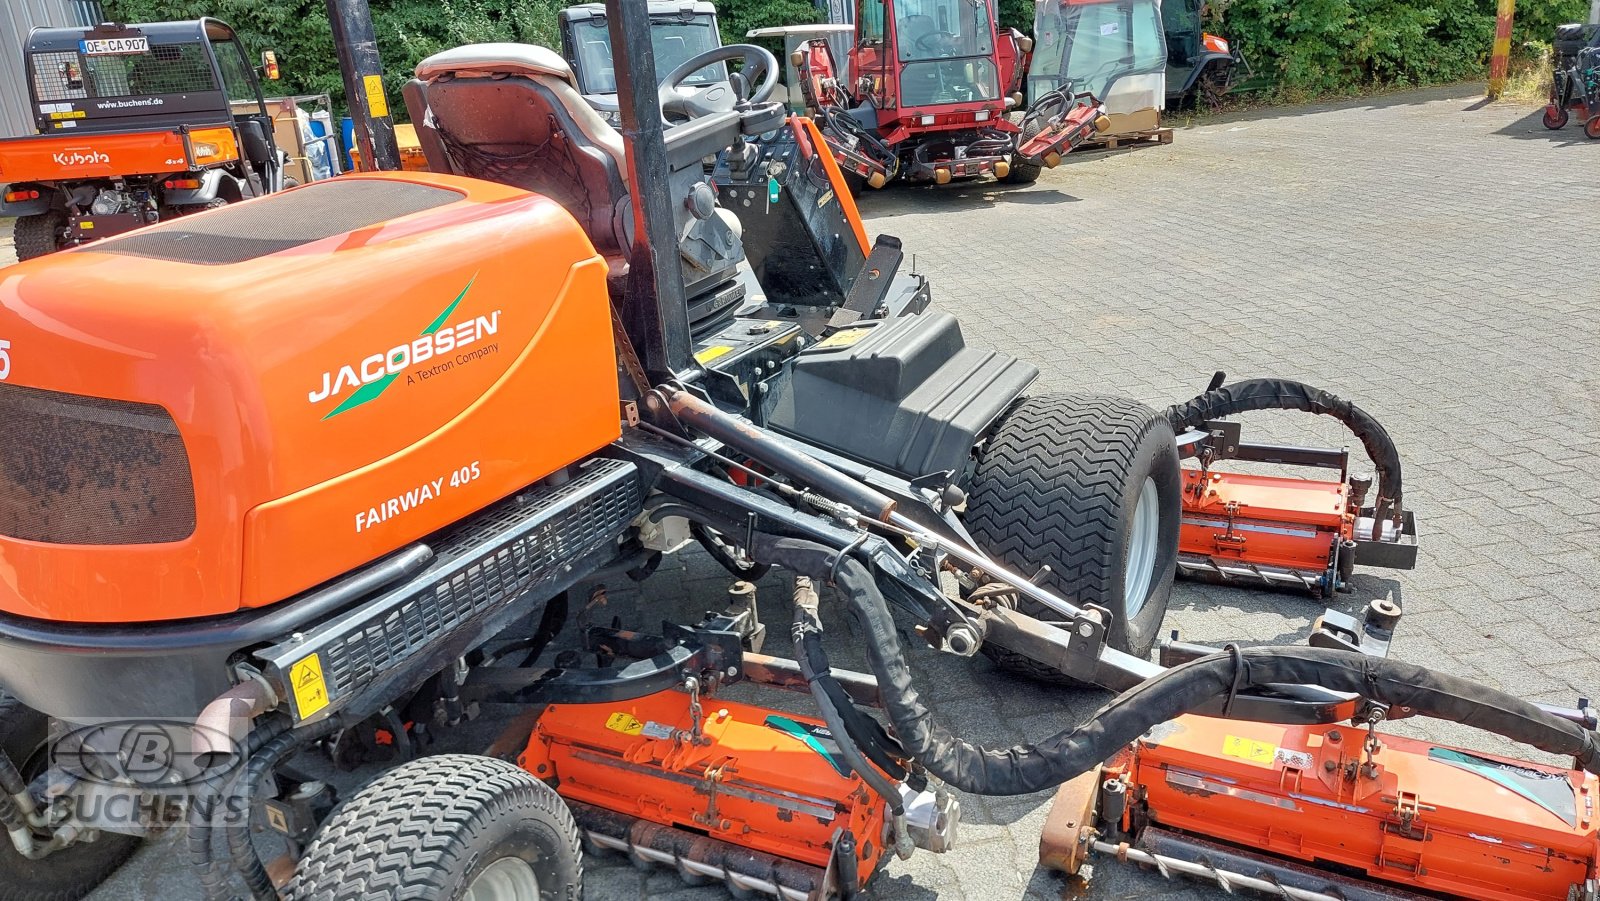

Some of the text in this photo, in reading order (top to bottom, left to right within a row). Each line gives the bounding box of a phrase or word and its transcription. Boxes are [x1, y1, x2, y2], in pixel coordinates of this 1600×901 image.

[87, 39, 145, 52] OE CA 907
[97, 98, 164, 109] www.buchens.de
[52, 151, 110, 165] Kubota
[308, 310, 500, 404] JACOBSEN
[406, 342, 499, 387] A Textron Company
[355, 460, 480, 533] FAIRWAY 405
